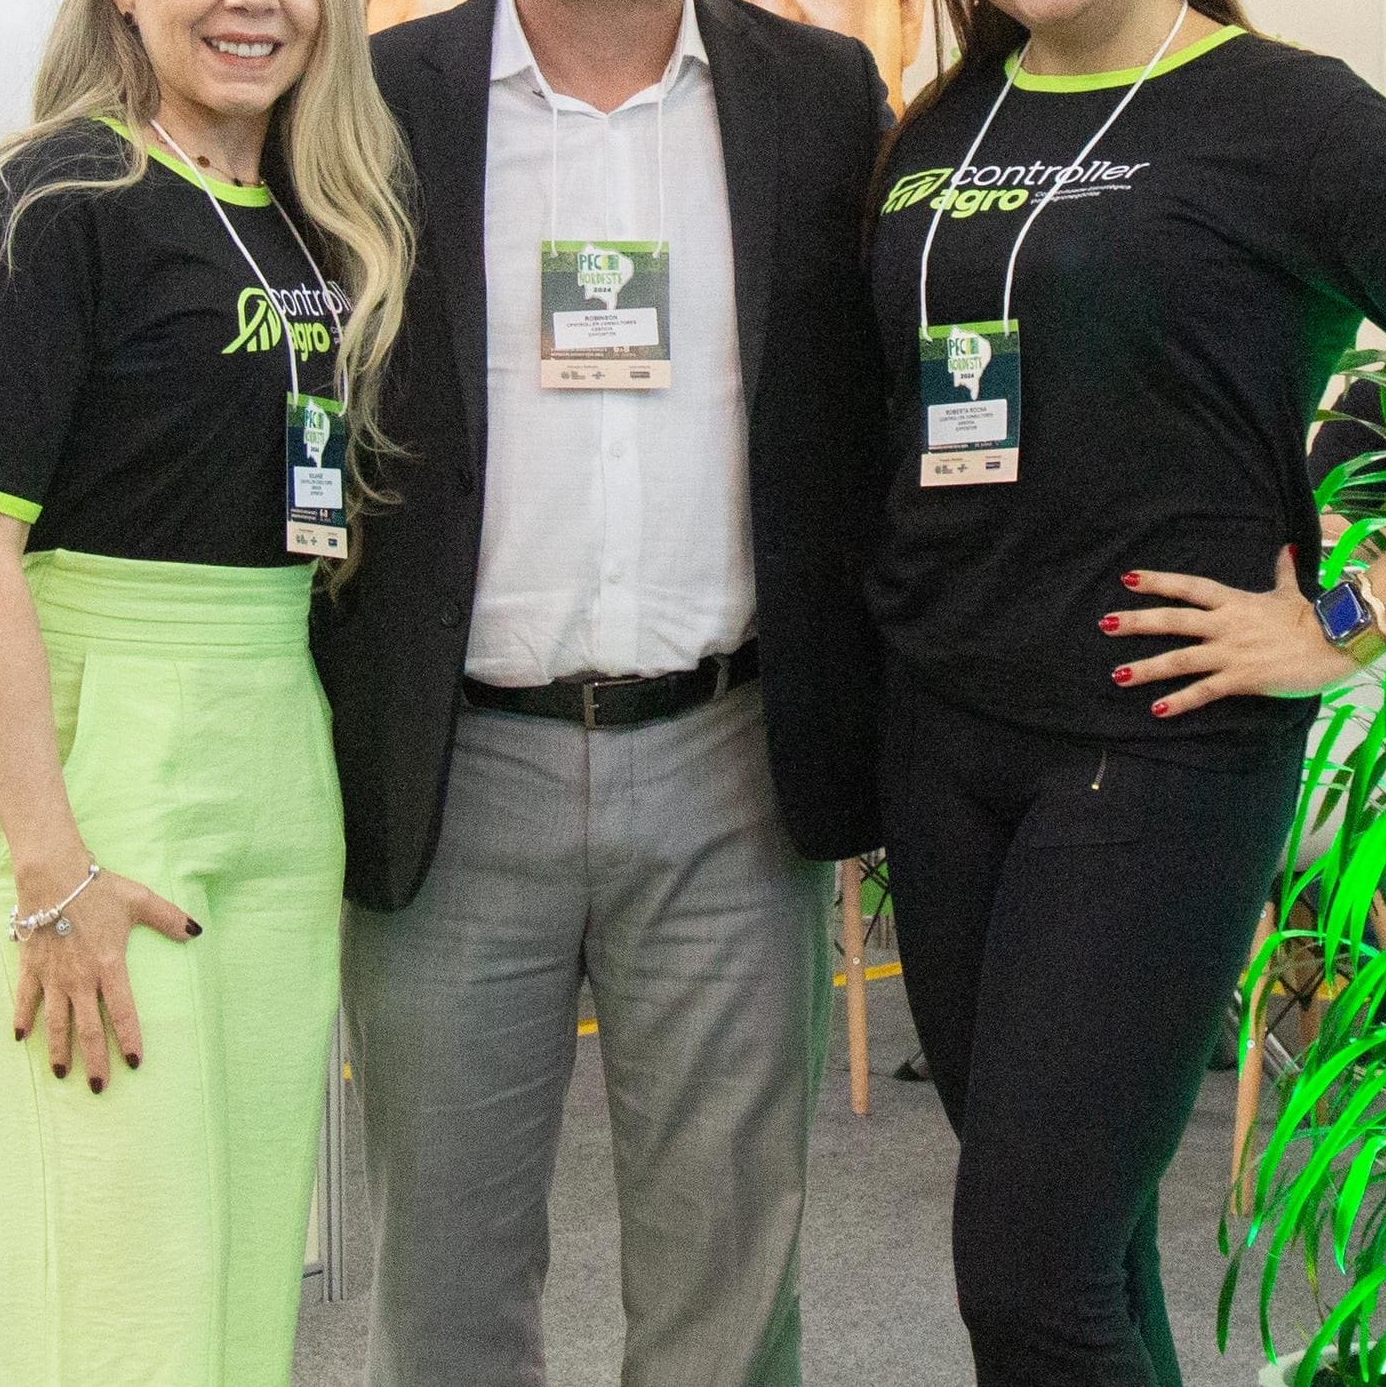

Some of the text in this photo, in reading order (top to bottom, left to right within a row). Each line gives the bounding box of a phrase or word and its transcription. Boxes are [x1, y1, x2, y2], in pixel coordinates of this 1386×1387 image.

[951, 160, 1151, 186] controller
[930, 188, 1029, 218] agro
[269, 280, 353, 316] controll
